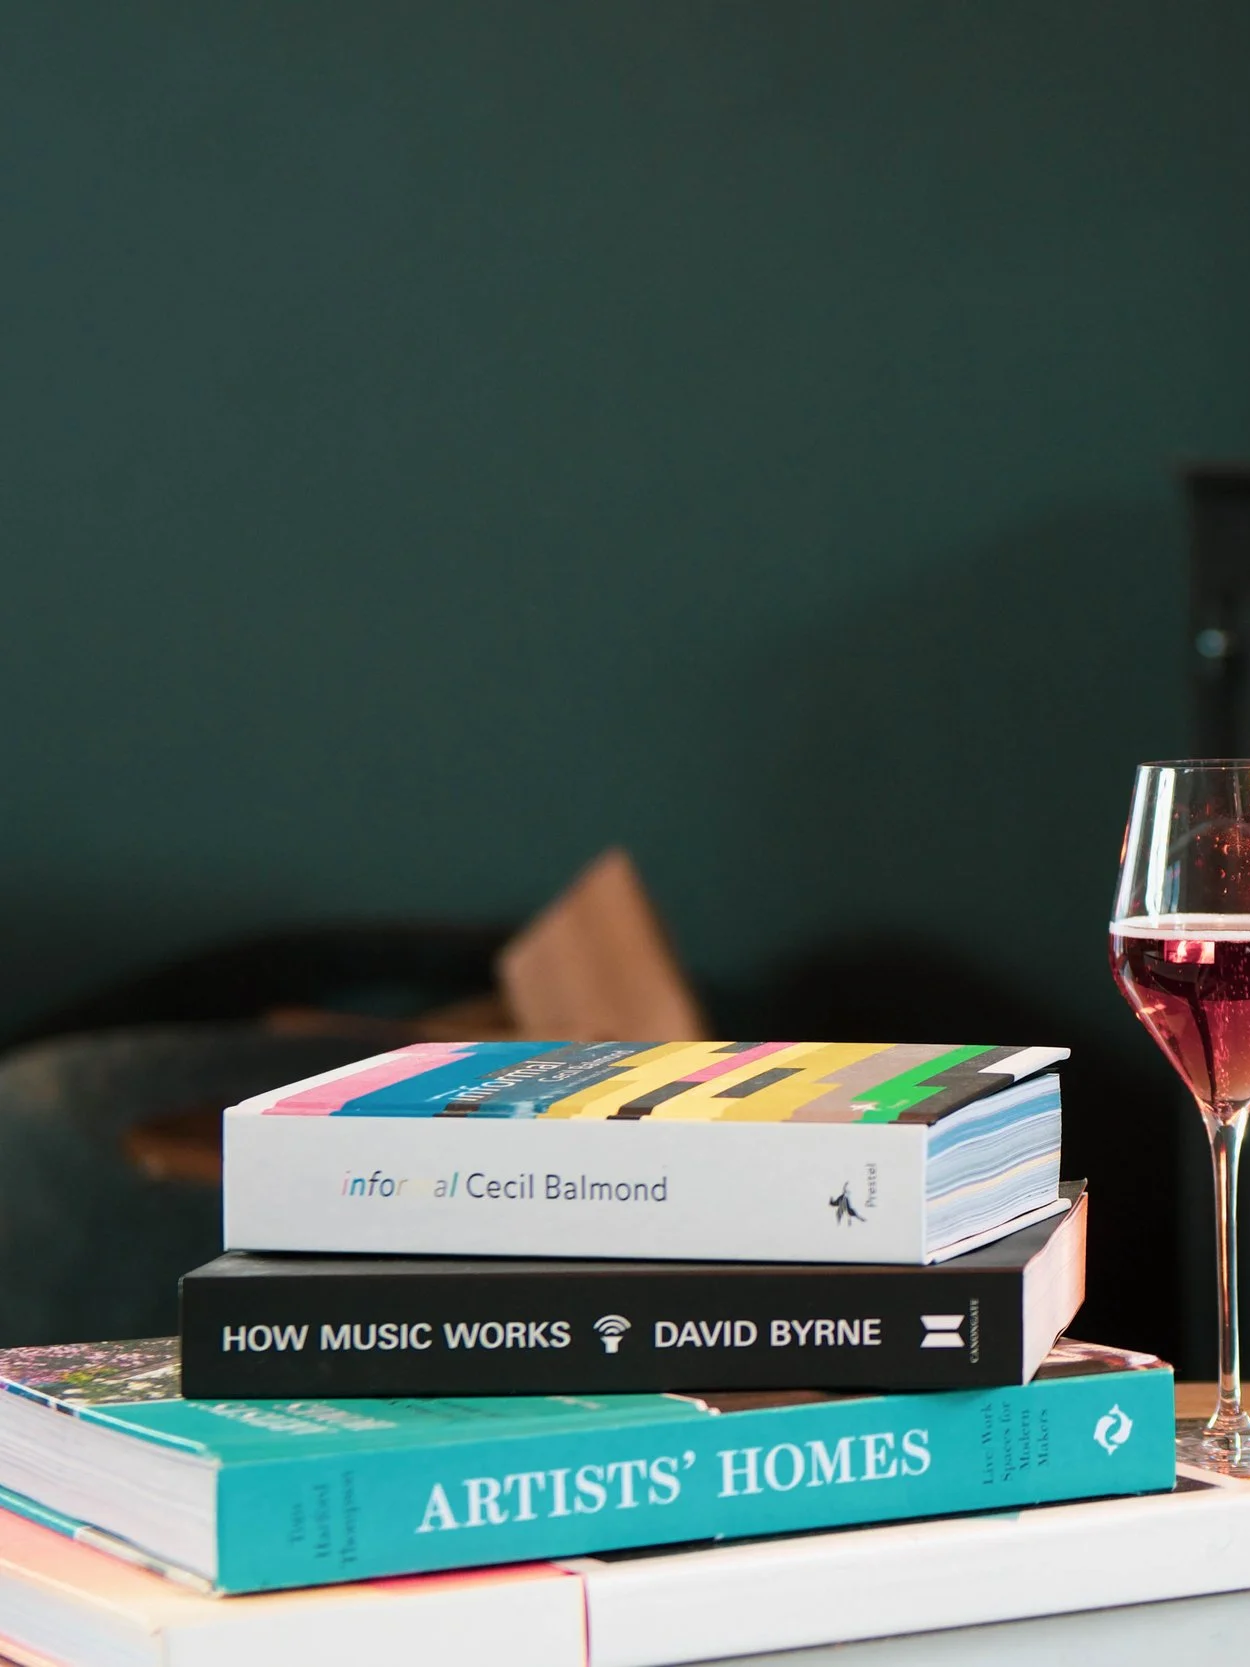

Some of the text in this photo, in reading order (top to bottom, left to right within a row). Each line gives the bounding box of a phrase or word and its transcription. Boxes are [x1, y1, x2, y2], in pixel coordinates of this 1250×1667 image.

[466, 1172, 535, 1199] Cecil
[545, 1174, 669, 1202] Balmond
[222, 1319, 572, 1353] HOW MUSIC WORKS
[654, 1318, 883, 1349] DAVID BYRNE
[980, 1402, 993, 1445] Work
[1018, 1409, 1030, 1471] Modern
[1036, 1408, 1049, 1467] Makers
[716, 1428, 932, 1499] HOMES
